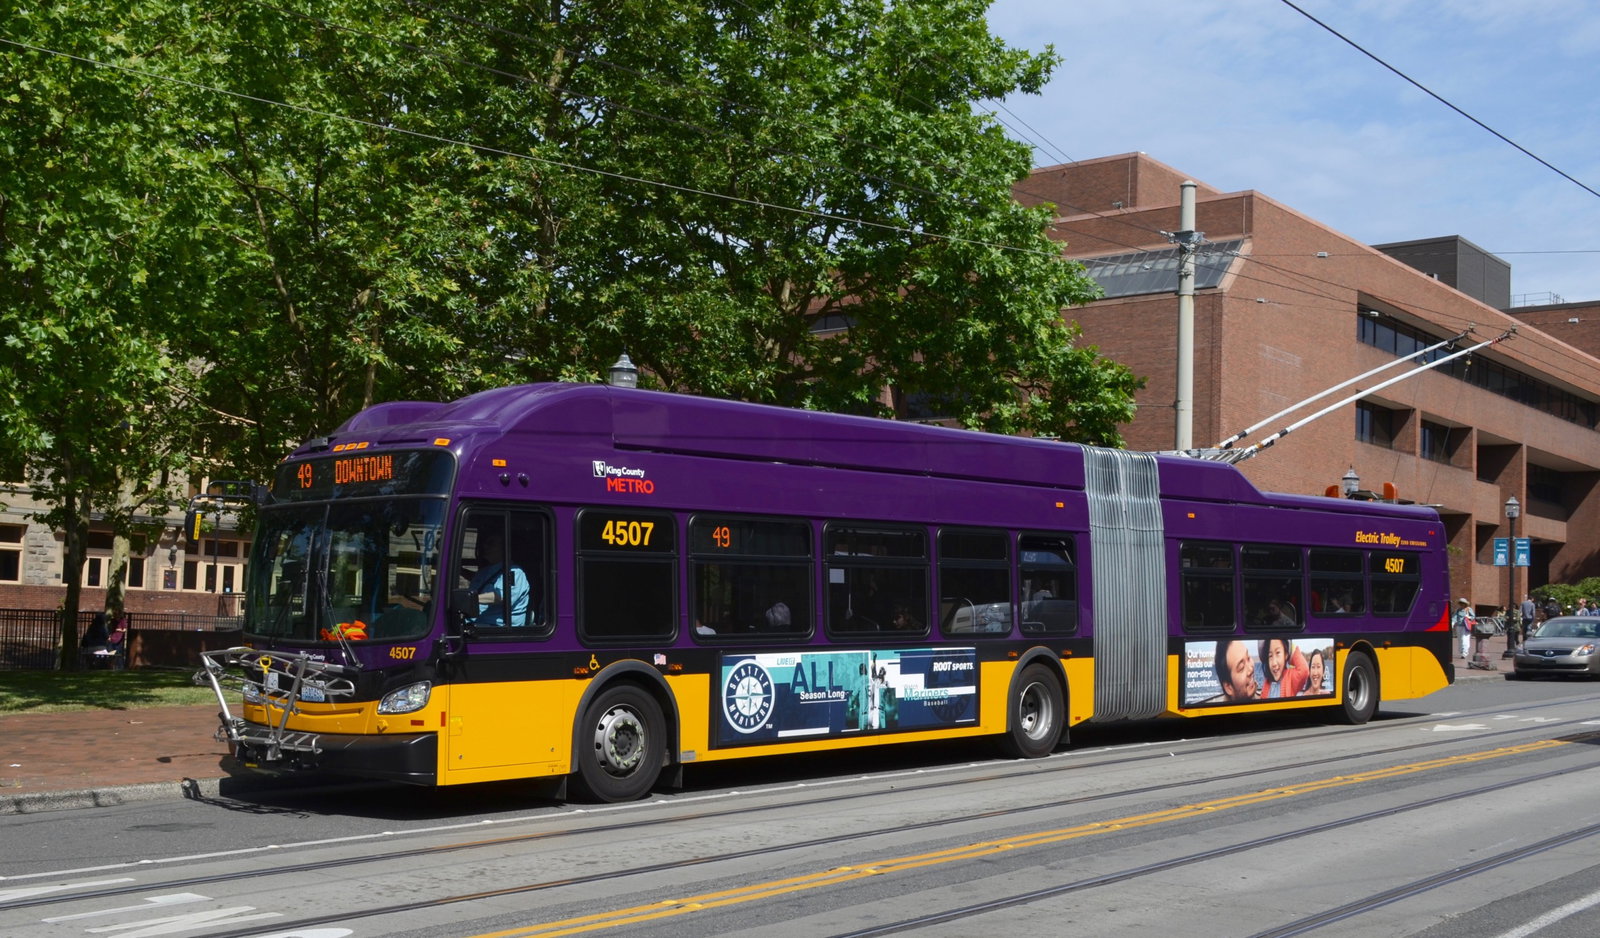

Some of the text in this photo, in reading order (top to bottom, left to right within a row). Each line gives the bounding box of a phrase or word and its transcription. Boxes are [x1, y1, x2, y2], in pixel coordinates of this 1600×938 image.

[297, 455, 393, 488] 49 DOWNTOWN
[606, 465, 645, 478] King County
[606, 477, 655, 494] METRO
[601, 520, 654, 546] 4507
[712, 526, 731, 548] 49
[1355, 531, 1380, 544] Electric
[1380, 532, 1401, 548] Trolley
[1384, 558, 1404, 573] 4507
[389, 647, 416, 659] 4507
[1187, 649, 1199, 658] Our
[933, 661, 952, 672] ROOT
[1187, 659, 1213, 668] funds our
[729, 665, 769, 690] SEATTLE
[790, 660, 843, 694] ALL
[1187, 669, 1213, 679] non-stop
[800, 690, 845, 700] Season Long
[903, 686, 949, 702] Mariners
[923, 699, 948, 707] Baseball
[728, 701, 770, 727] MARINERS
